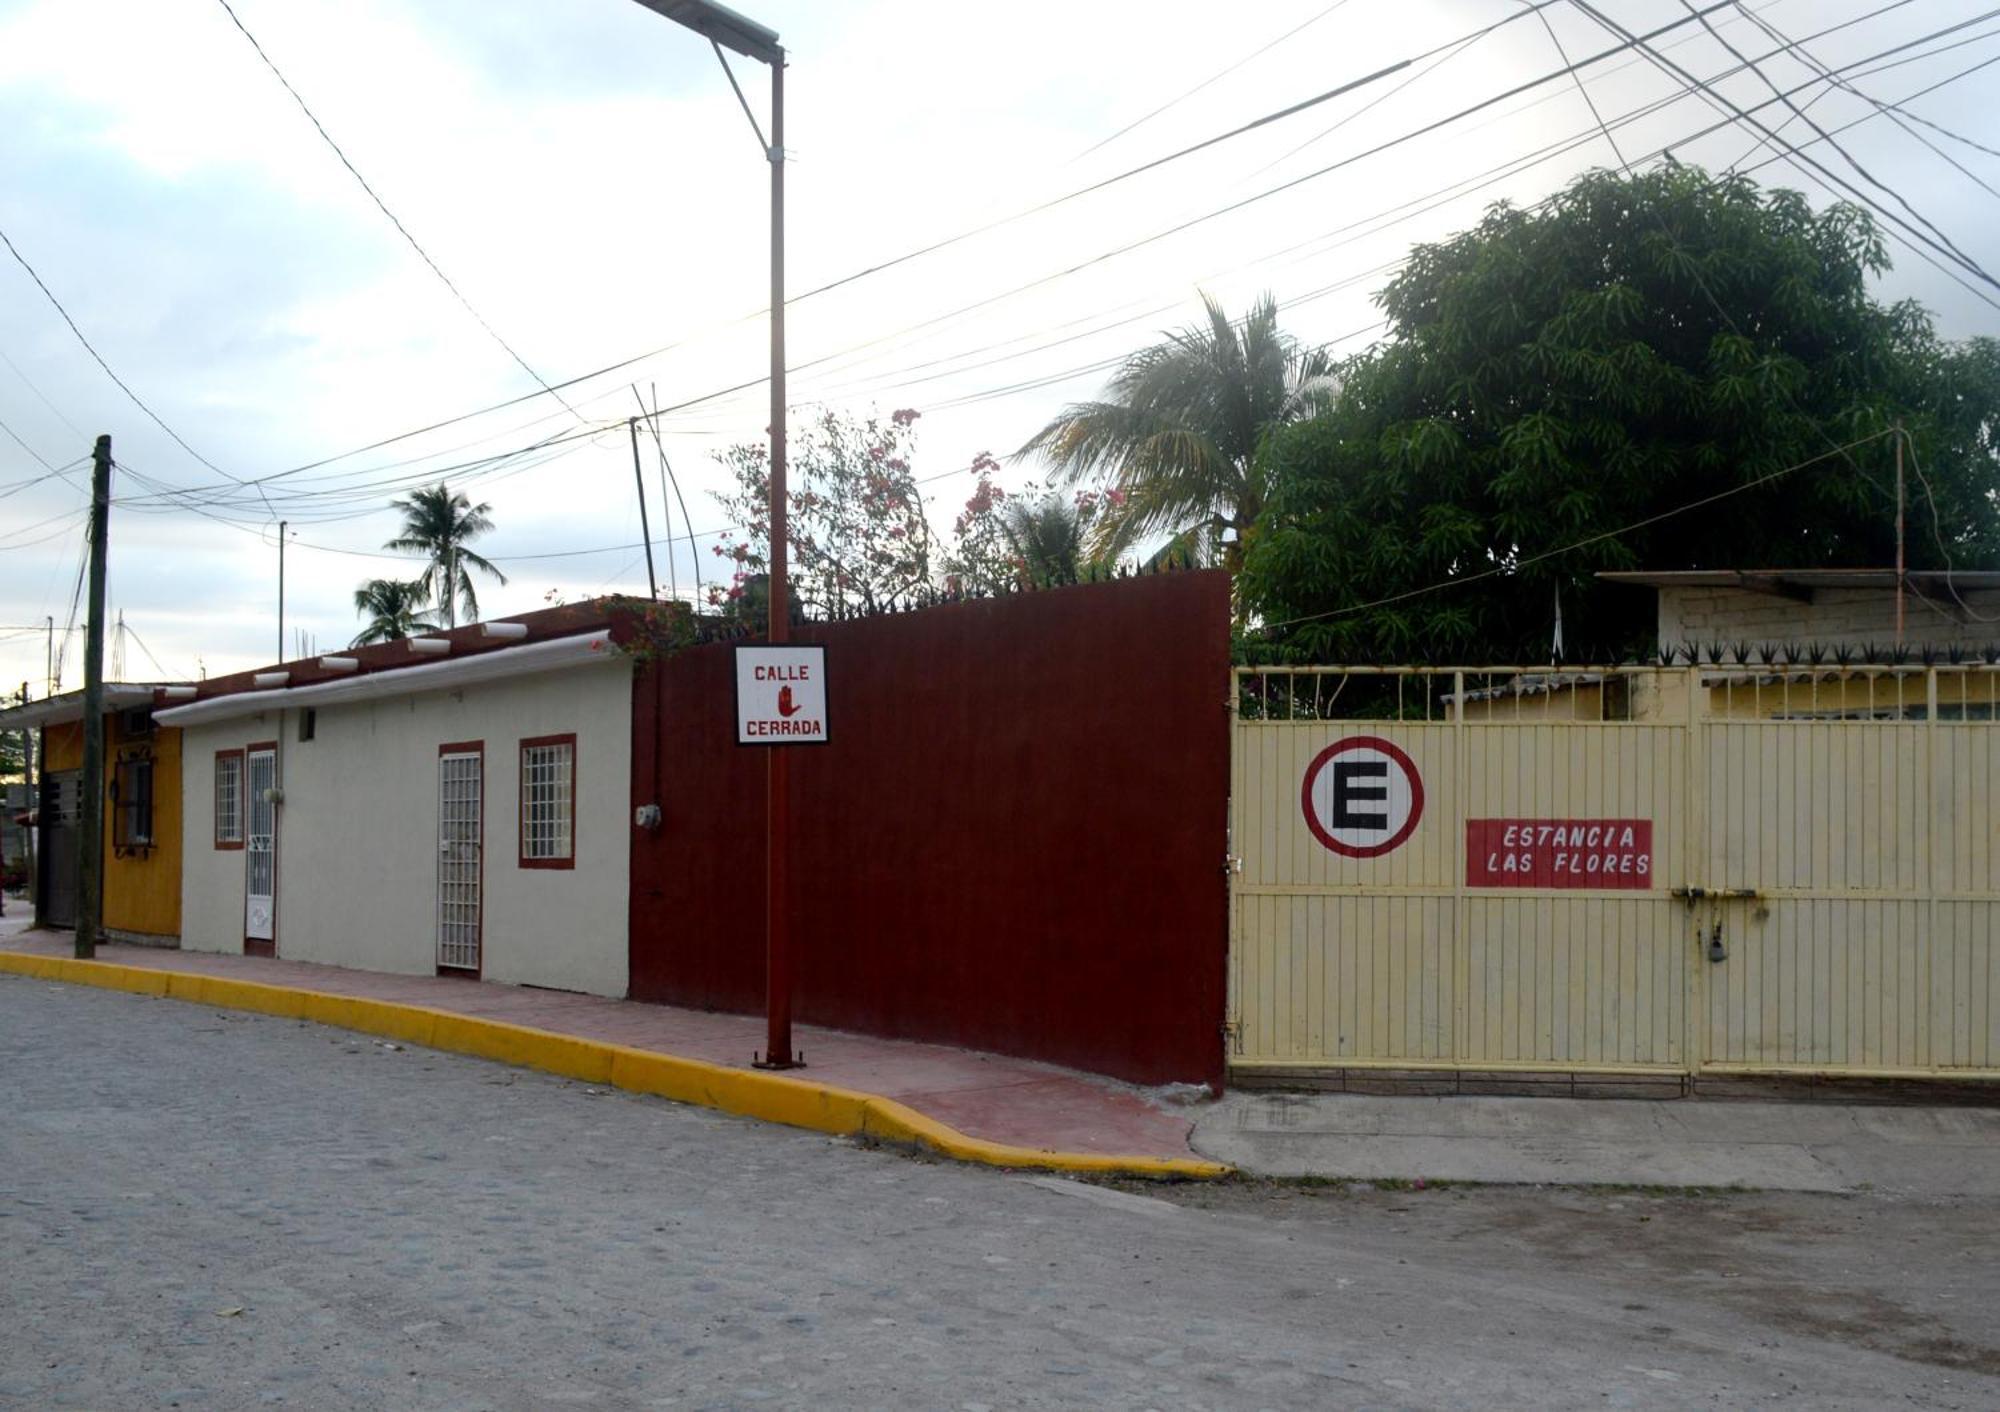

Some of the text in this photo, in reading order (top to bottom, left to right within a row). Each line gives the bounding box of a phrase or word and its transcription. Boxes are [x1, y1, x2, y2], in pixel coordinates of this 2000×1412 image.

[755, 665, 809, 681] CALLE
[747, 720, 821, 735] CERRADA
[1333, 762, 1387, 830] E
[1503, 826, 1634, 847] ESTANCIA
[1488, 853, 1648, 874] LAS FLORES
